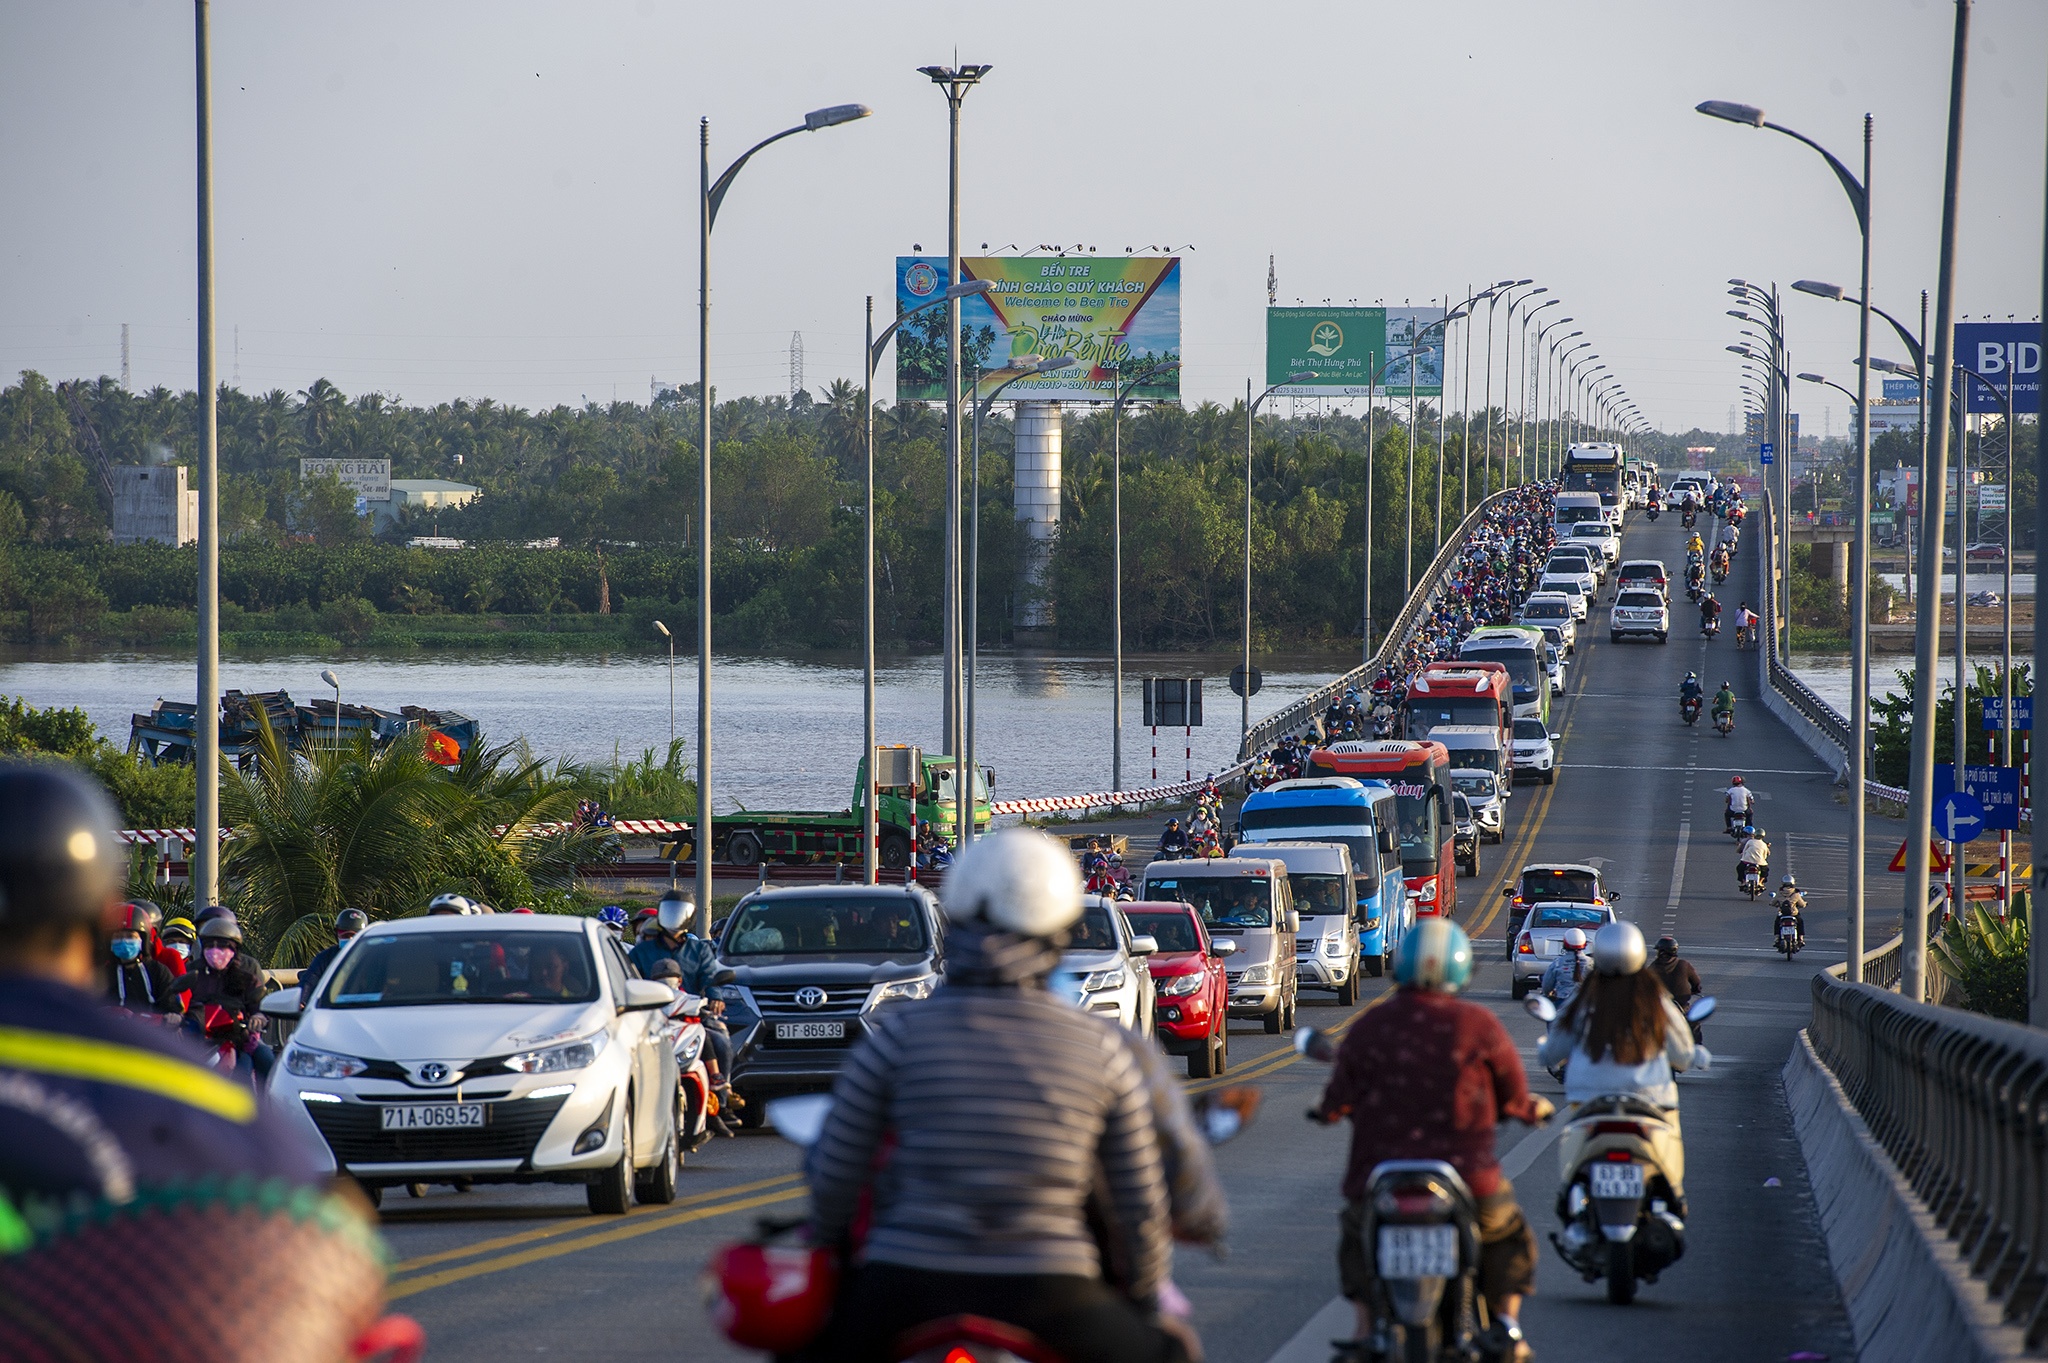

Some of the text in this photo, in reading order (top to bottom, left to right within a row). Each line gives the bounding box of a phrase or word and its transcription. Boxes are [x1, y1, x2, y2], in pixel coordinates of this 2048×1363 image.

[1041, 262, 1091, 277] BẾN TRE
[1023, 280, 1063, 293] CHÀO
[1066, 280, 1095, 294] QUÝ
[1097, 280, 1145, 293] KHÁCH
[1004, 296, 1129, 307] Welcome to Ben Tre
[1041, 314, 1093, 323] CHÀO MỪNG
[1097, 327, 1130, 367] Tre
[1101, 360, 1120, 369] 2019
[1290, 358, 1305, 367] Biệt
[1324, 358, 1345, 369] Hưng
[1347, 358, 1361, 367] Phú
[1061, 369, 1081, 378] THỨ
[1082, 370, 1090, 378] V
[1885, 381, 1920, 390] THÉP HÒ
[1989, 771, 1998, 783] TRE
[777, 1024, 842, 1038] 51F-869.39
[385, 1106, 480, 1127] 71A-069.52
